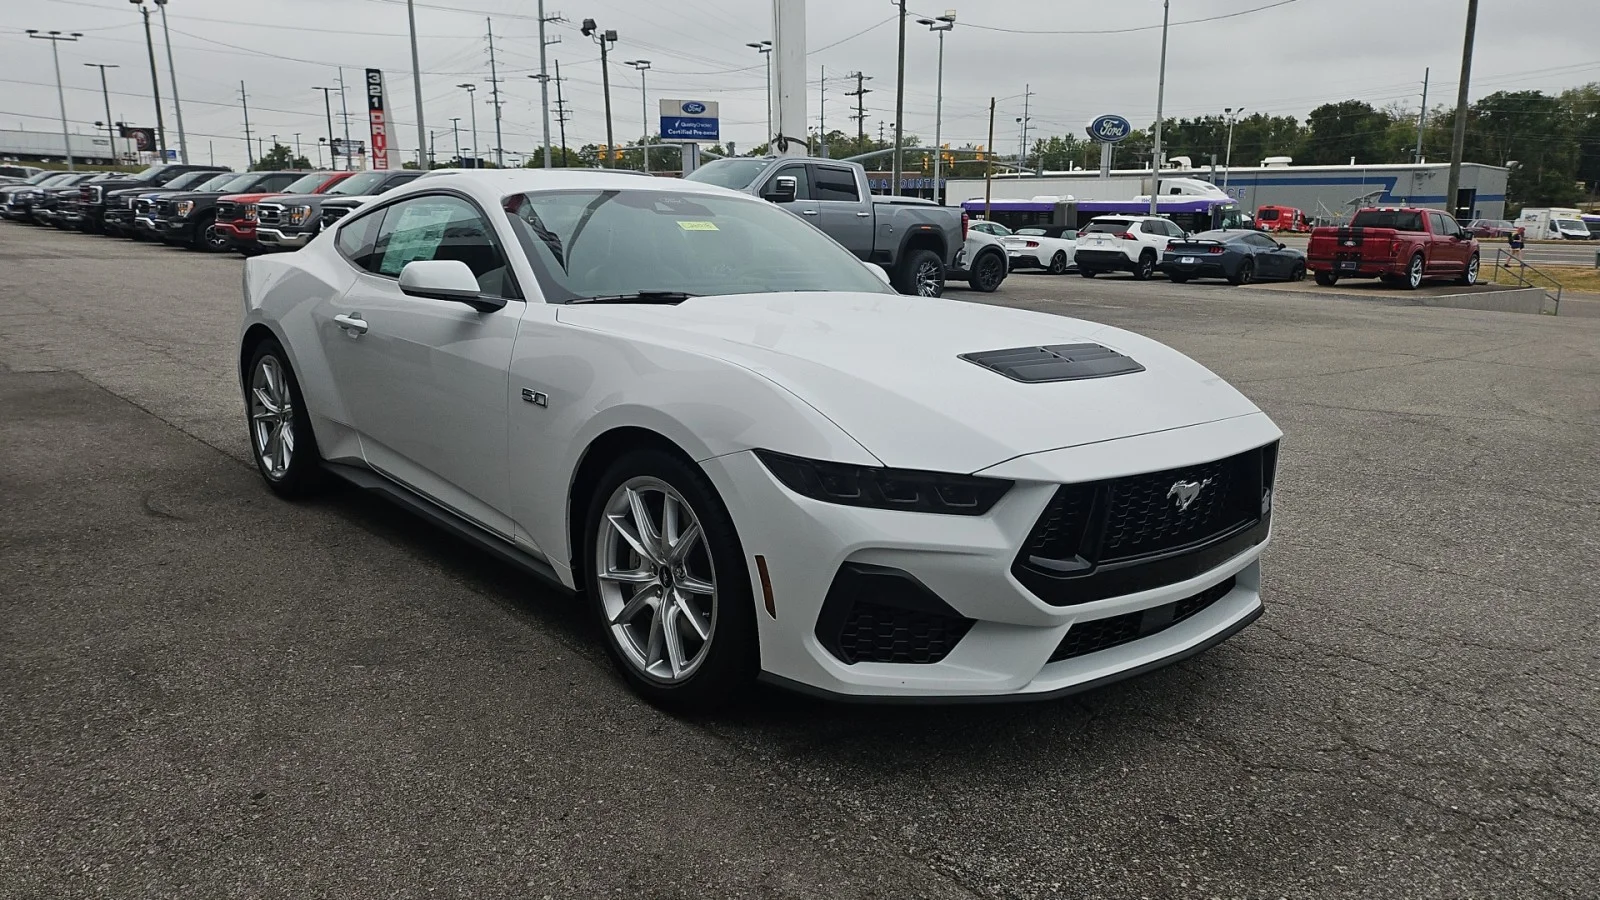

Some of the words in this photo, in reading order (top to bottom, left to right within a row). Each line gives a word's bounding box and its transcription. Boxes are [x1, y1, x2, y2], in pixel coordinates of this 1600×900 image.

[368, 72, 382, 108] 321
[687, 103, 702, 112] Ford
[370, 112, 387, 169] DRIVE
[1100, 119, 1124, 136] Ford
